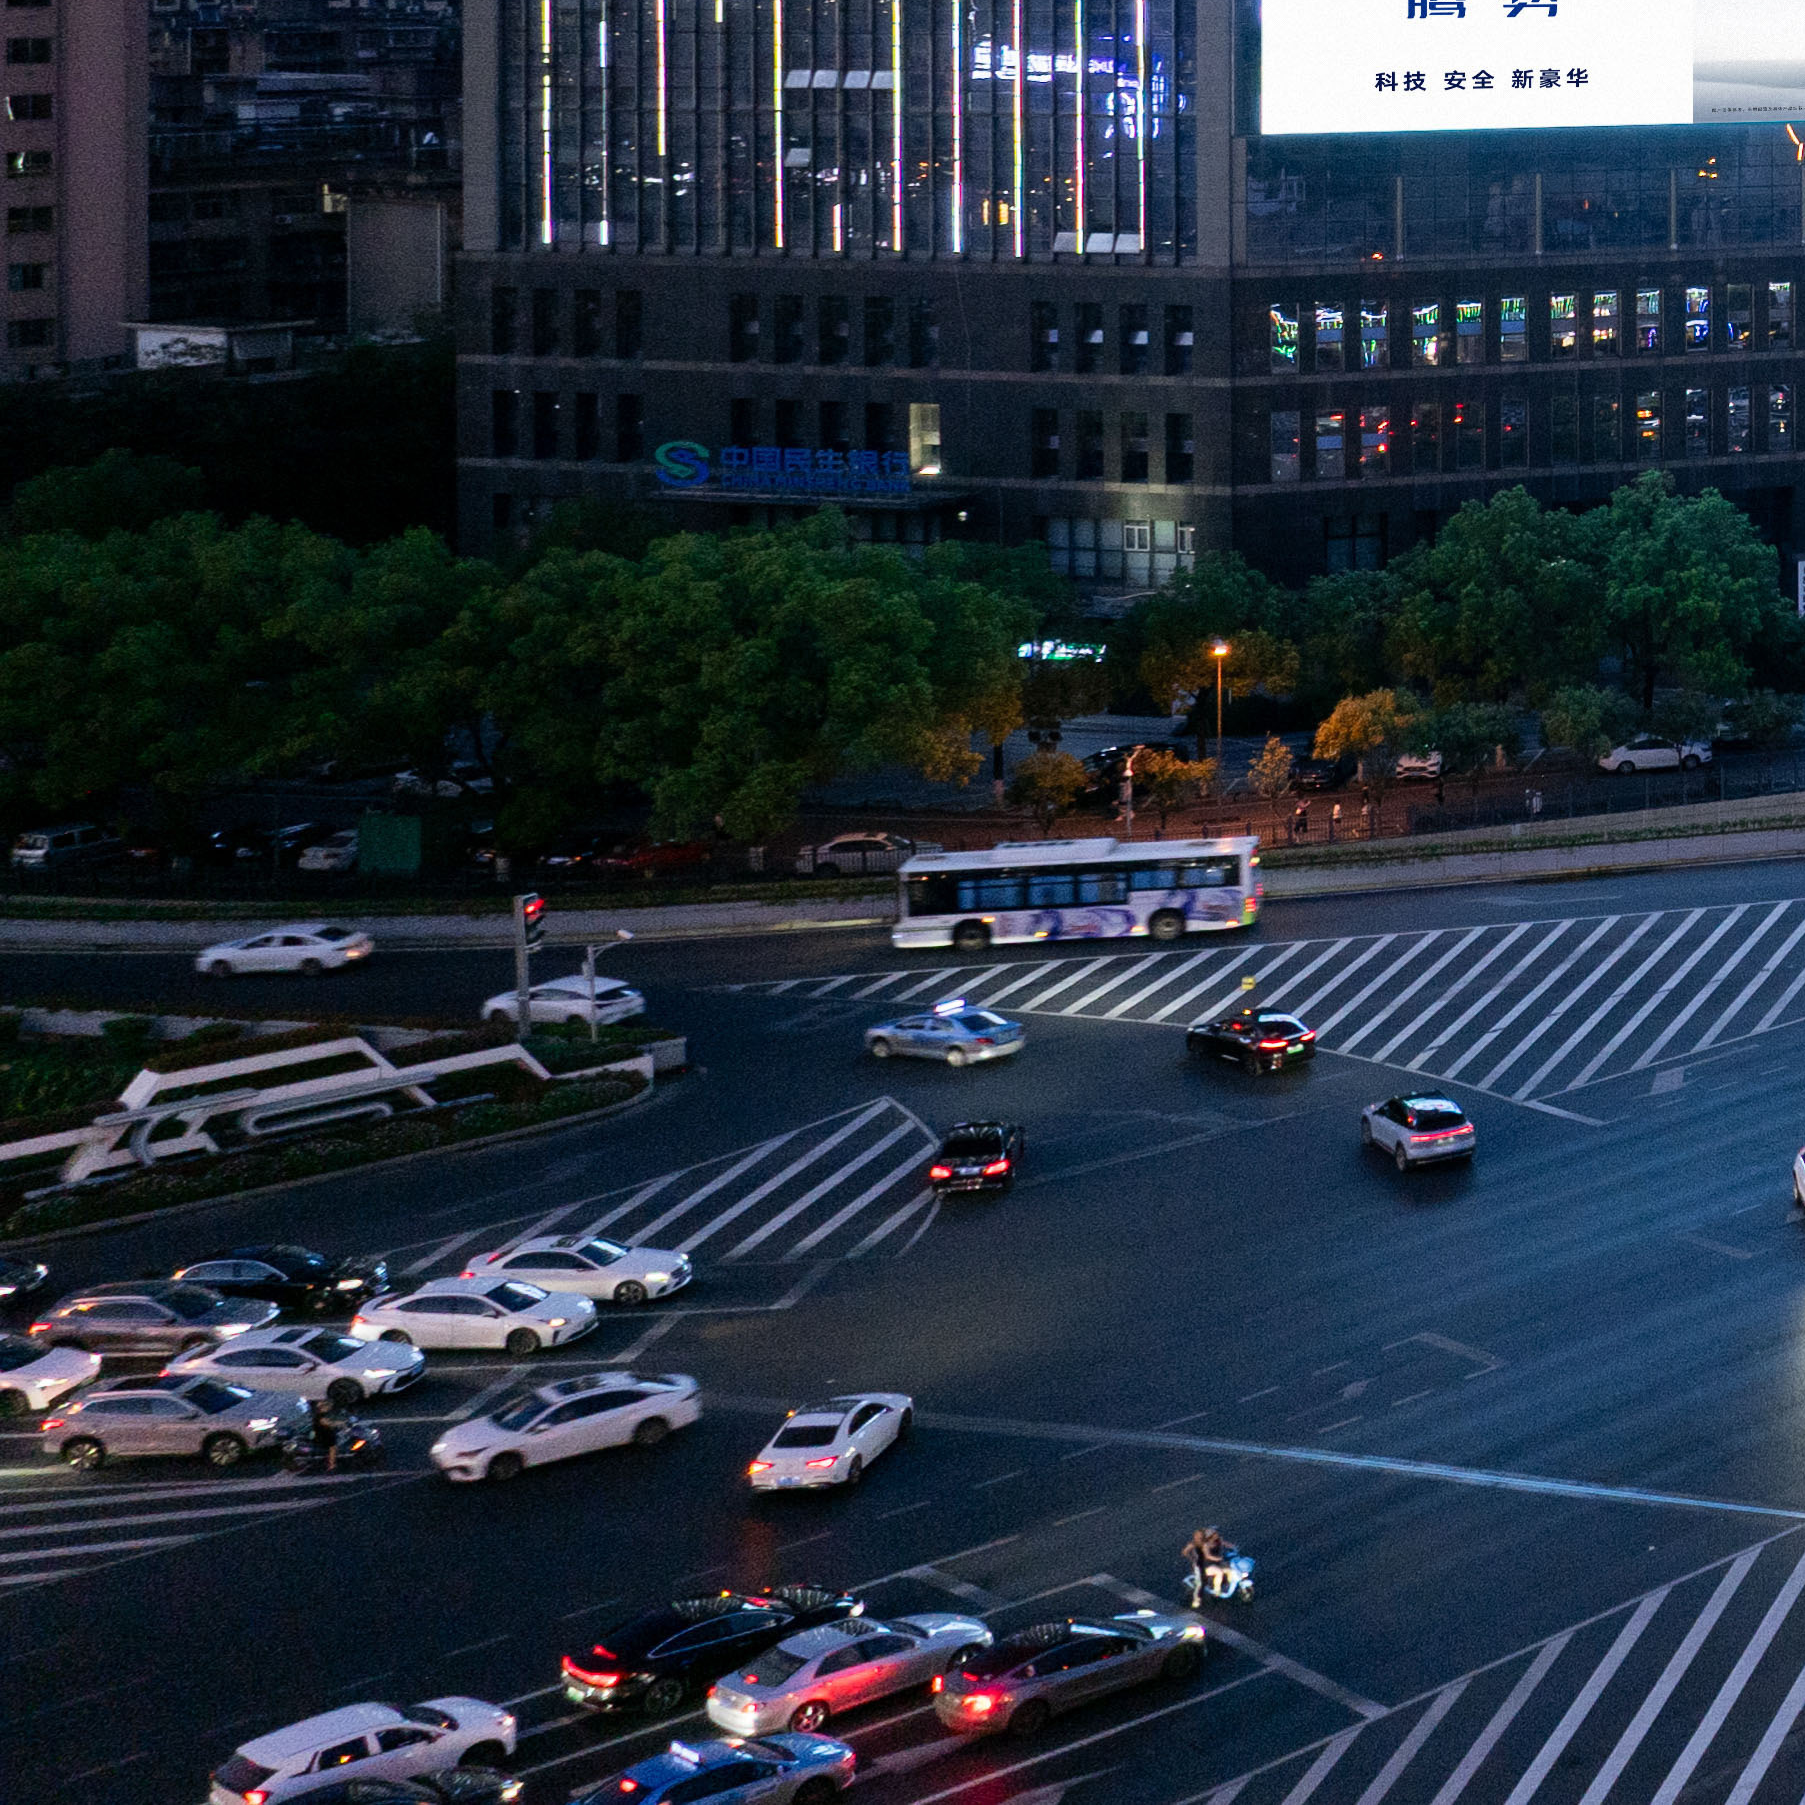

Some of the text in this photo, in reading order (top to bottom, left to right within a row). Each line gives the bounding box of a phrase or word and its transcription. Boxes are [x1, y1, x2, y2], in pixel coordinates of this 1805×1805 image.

[1374, 67, 1590, 93] 科技 安全 新豪华
[720, 445, 910, 475] 中国民生银行
